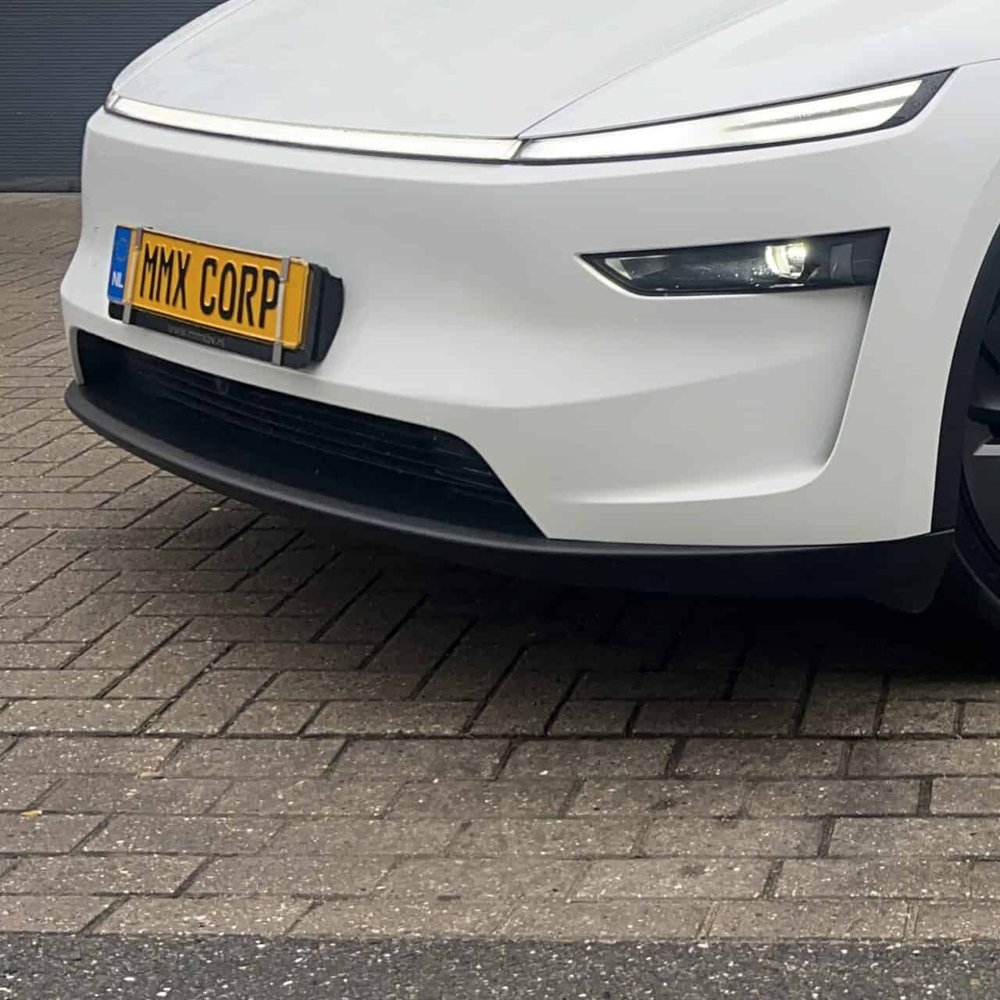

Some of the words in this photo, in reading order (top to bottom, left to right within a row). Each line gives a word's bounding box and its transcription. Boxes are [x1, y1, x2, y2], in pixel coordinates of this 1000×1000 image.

[111, 270, 124, 289] NL
[139, 243, 192, 310] MMX
[199, 257, 280, 329] CORP
